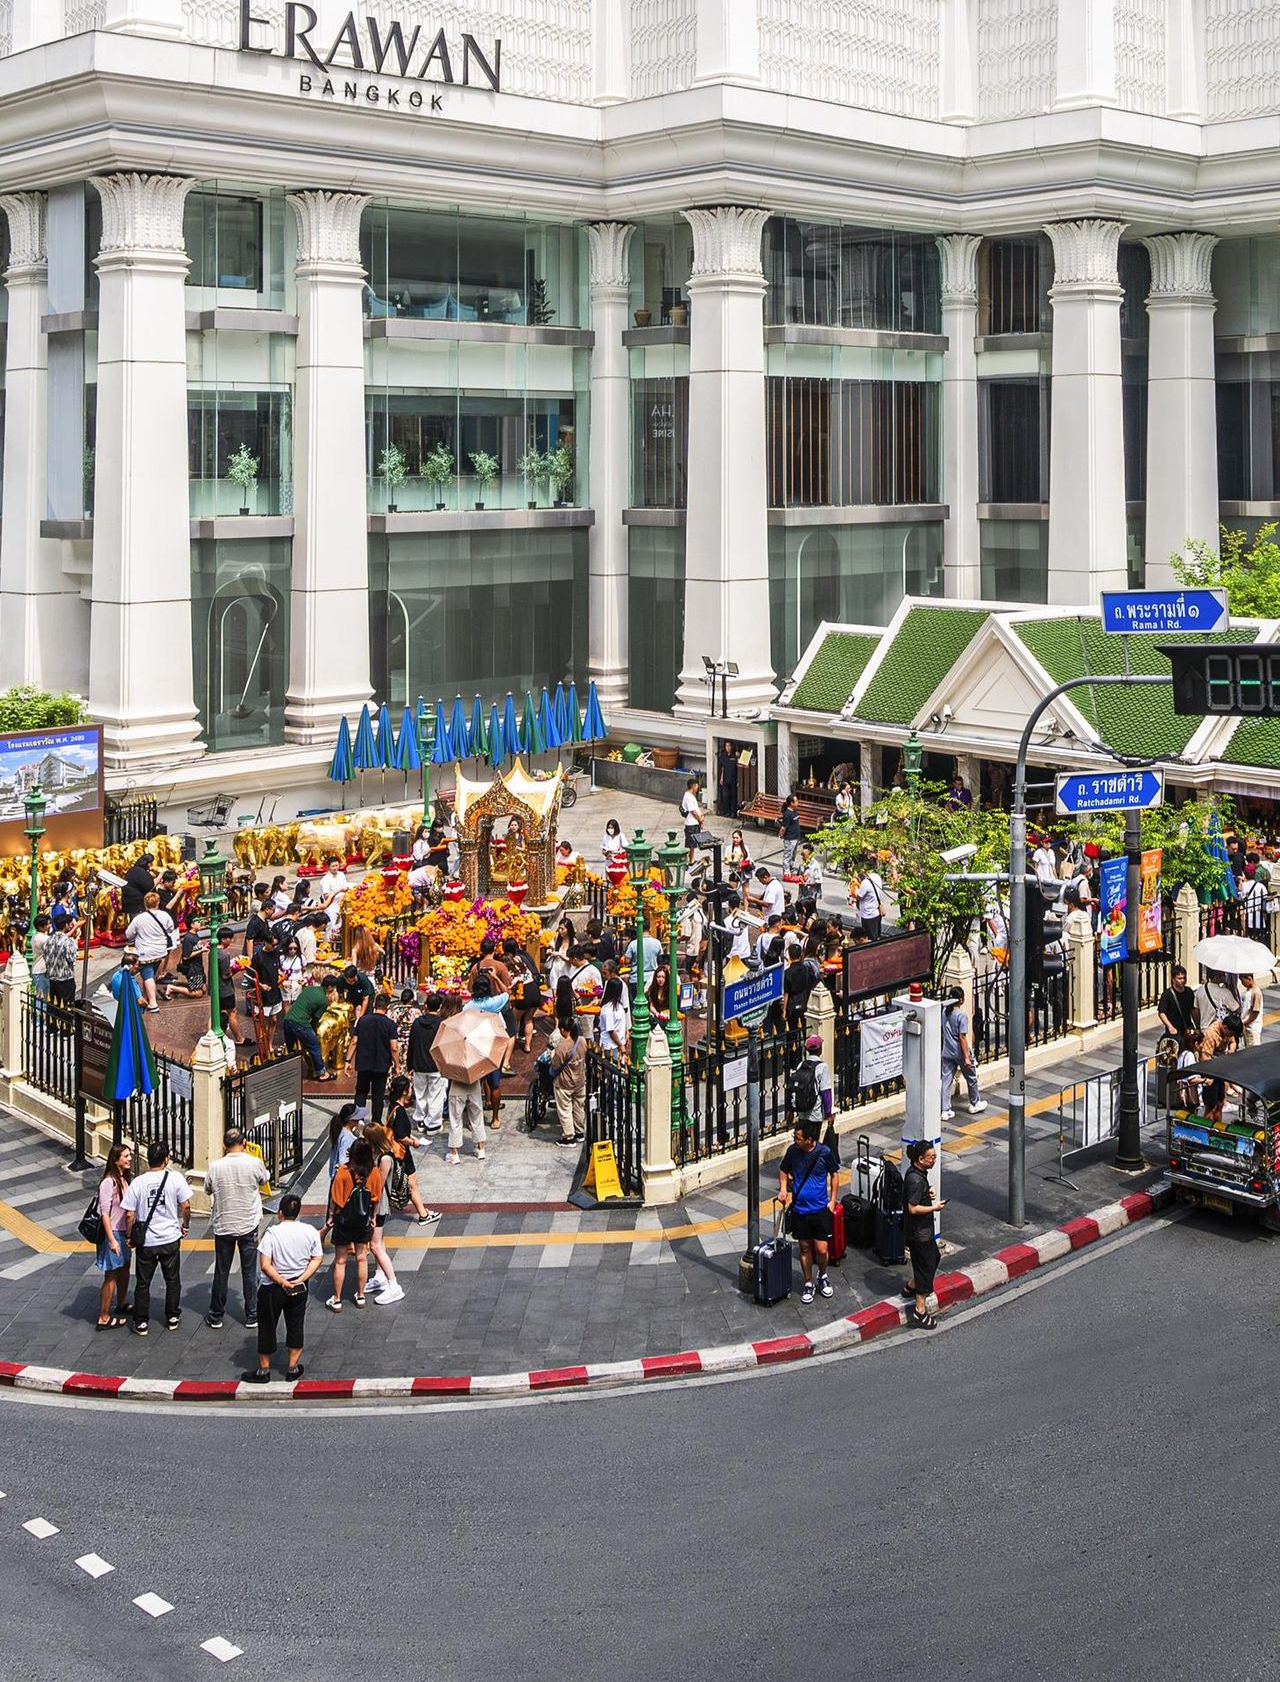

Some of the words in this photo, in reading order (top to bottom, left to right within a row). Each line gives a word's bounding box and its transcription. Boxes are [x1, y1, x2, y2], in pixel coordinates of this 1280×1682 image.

[299, 75, 445, 112] BANGKOK
[1114, 605, 1125, 620] ถ.
[1127, 593, 1186, 619] พระรามที่
[1132, 620, 1158, 630] Rama
[1167, 620, 1182, 629] Rd.
[1078, 782, 1089, 795] ถ.
[1092, 772, 1143, 793] ราชดำริ
[1077, 796, 1125, 808] Ratchadamri
[1129, 796, 1142, 804] Rd.
[734, 973, 774, 1001] ถนนราชดำริ
[733, 1002, 748, 1011] Thanon
[1009, 1067, 1015, 1077] 8
[1019, 1080, 1025, 1091] 8
